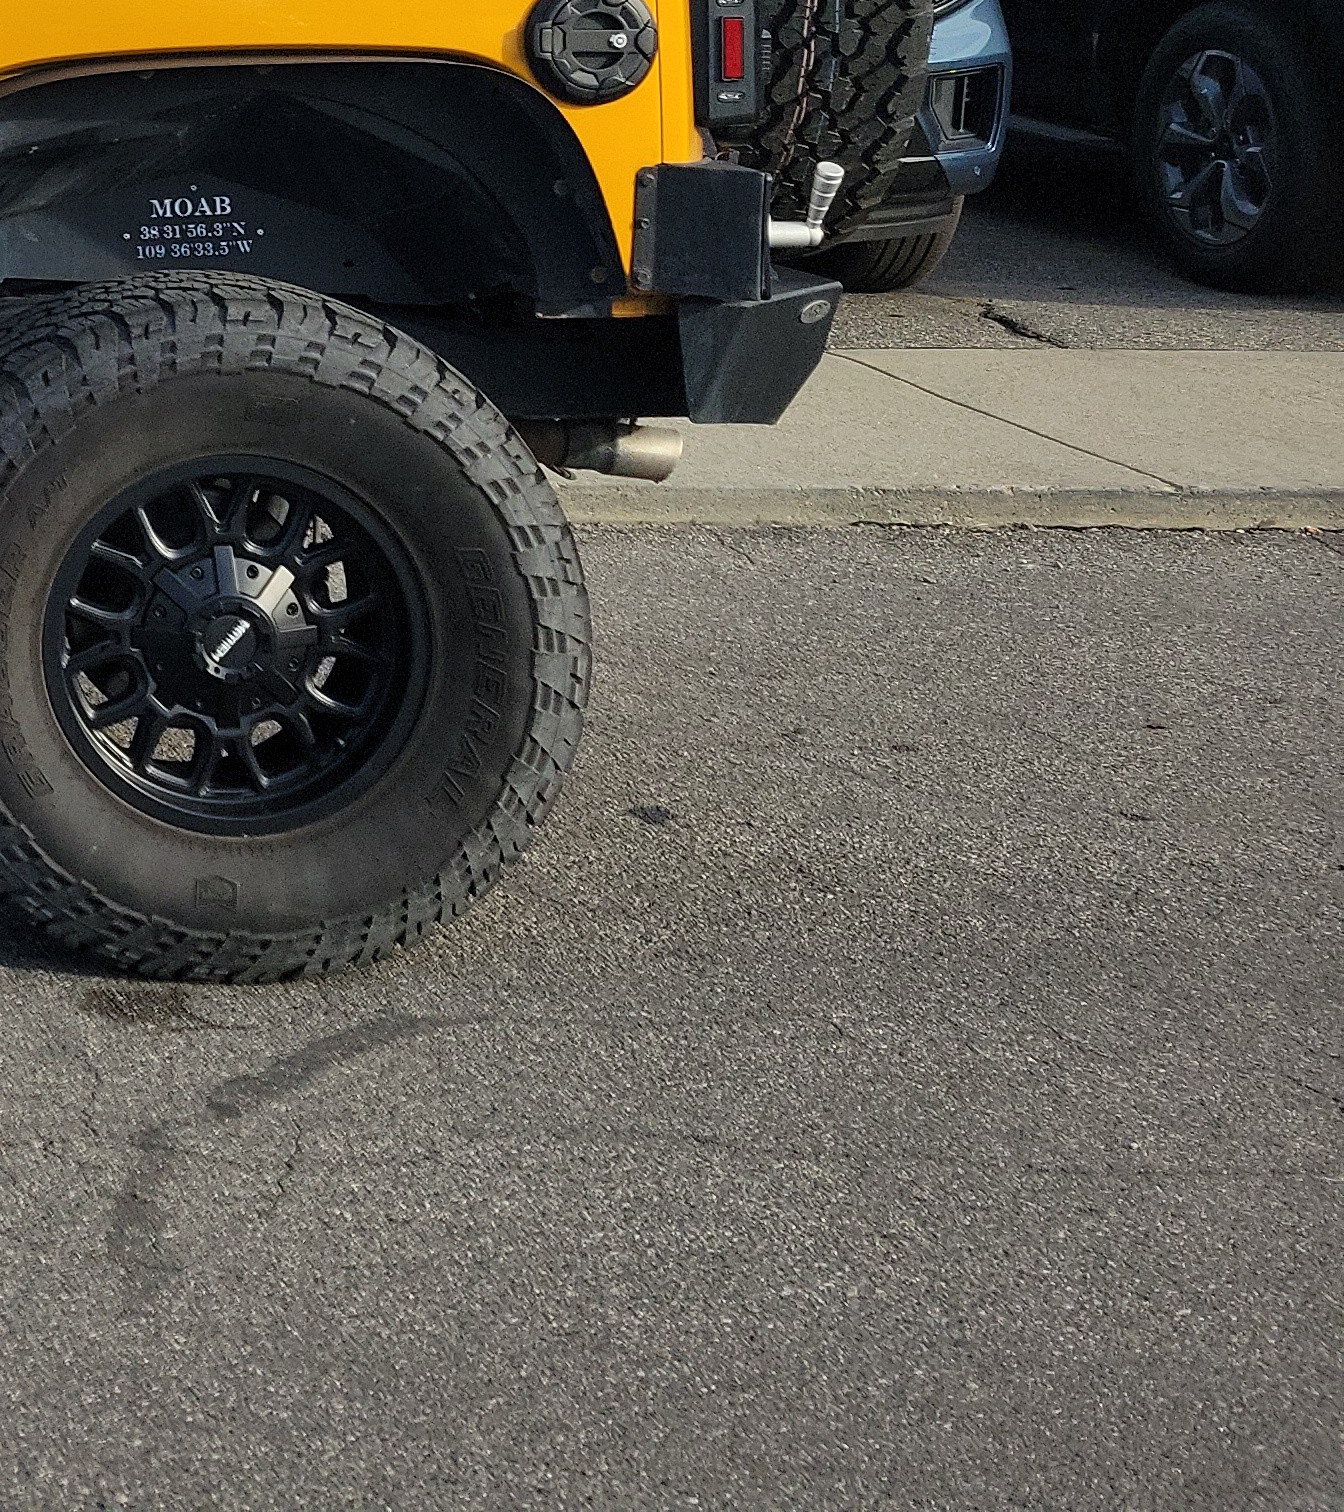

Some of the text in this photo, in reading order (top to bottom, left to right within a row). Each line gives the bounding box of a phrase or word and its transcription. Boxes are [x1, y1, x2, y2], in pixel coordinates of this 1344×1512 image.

[149, 196, 232, 218] MOAB
[139, 225, 160, 240] 38
[136, 244, 166, 259] 109
[425, 545, 509, 805] GENERAL
